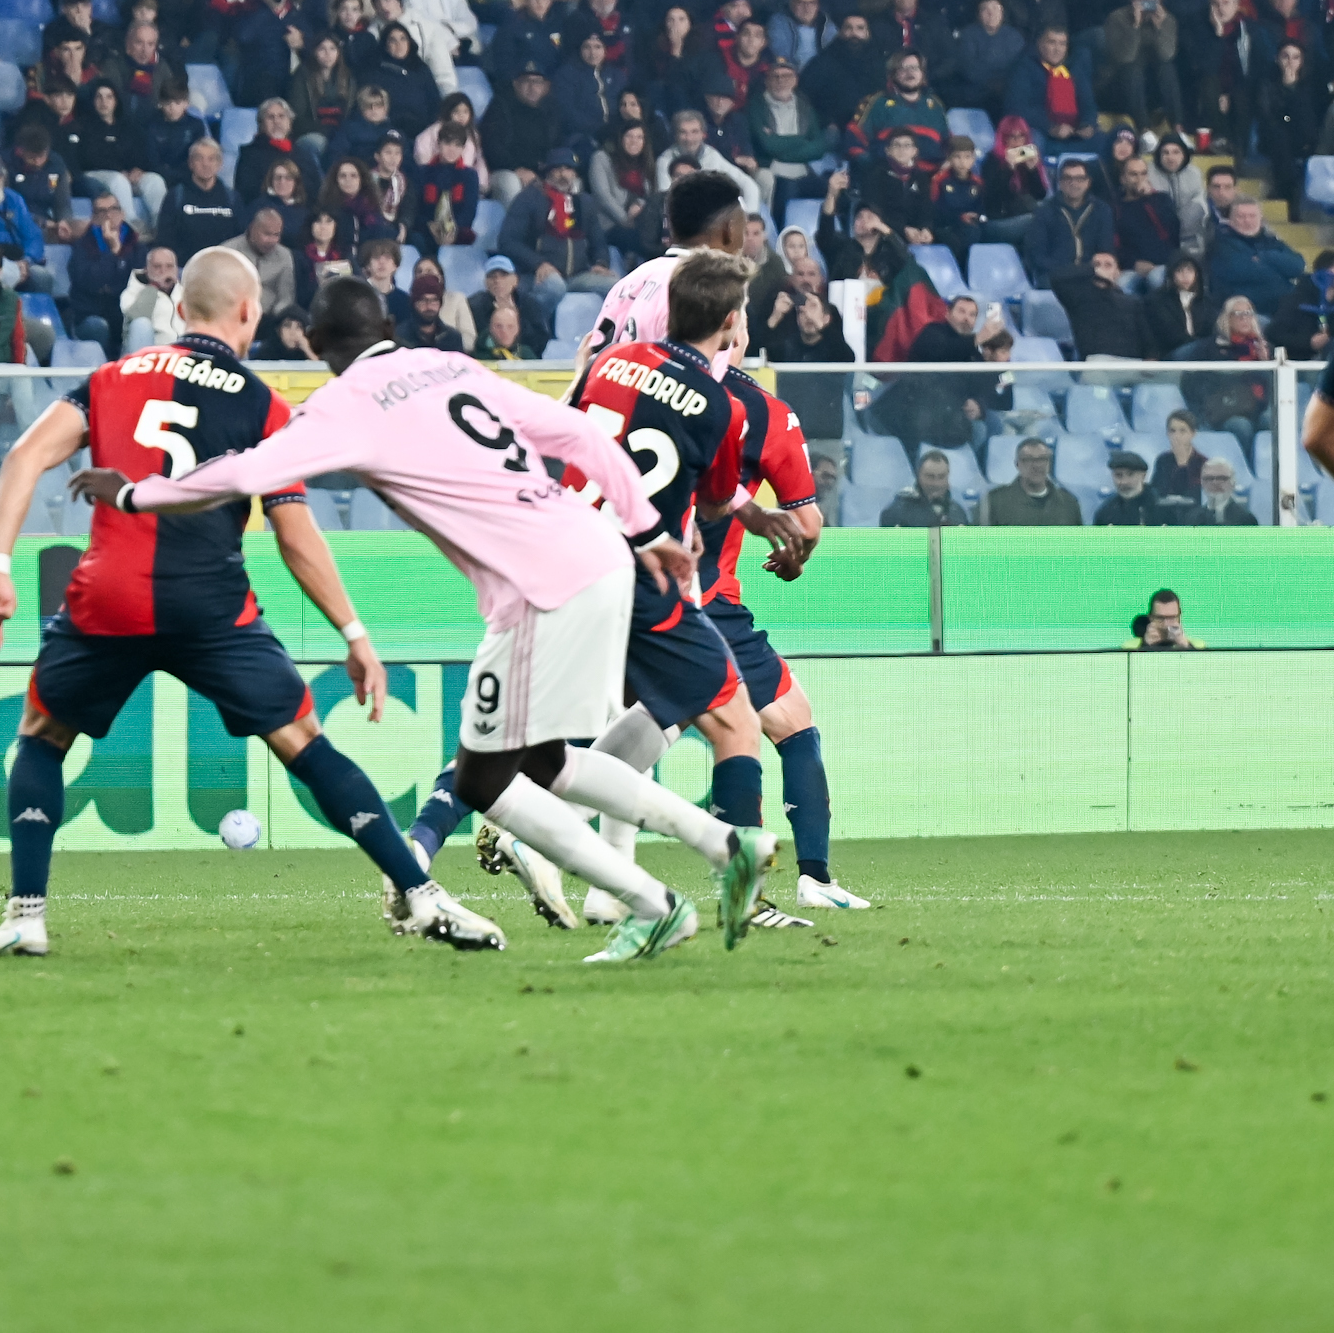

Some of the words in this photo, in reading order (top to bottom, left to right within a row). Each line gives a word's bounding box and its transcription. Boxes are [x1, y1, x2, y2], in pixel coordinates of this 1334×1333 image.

[120, 352, 245, 393] ØSTIGÅRD
[597, 357, 708, 418] FRENDRUP
[134, 399, 198, 479] 5
[476, 671, 501, 714] 9
